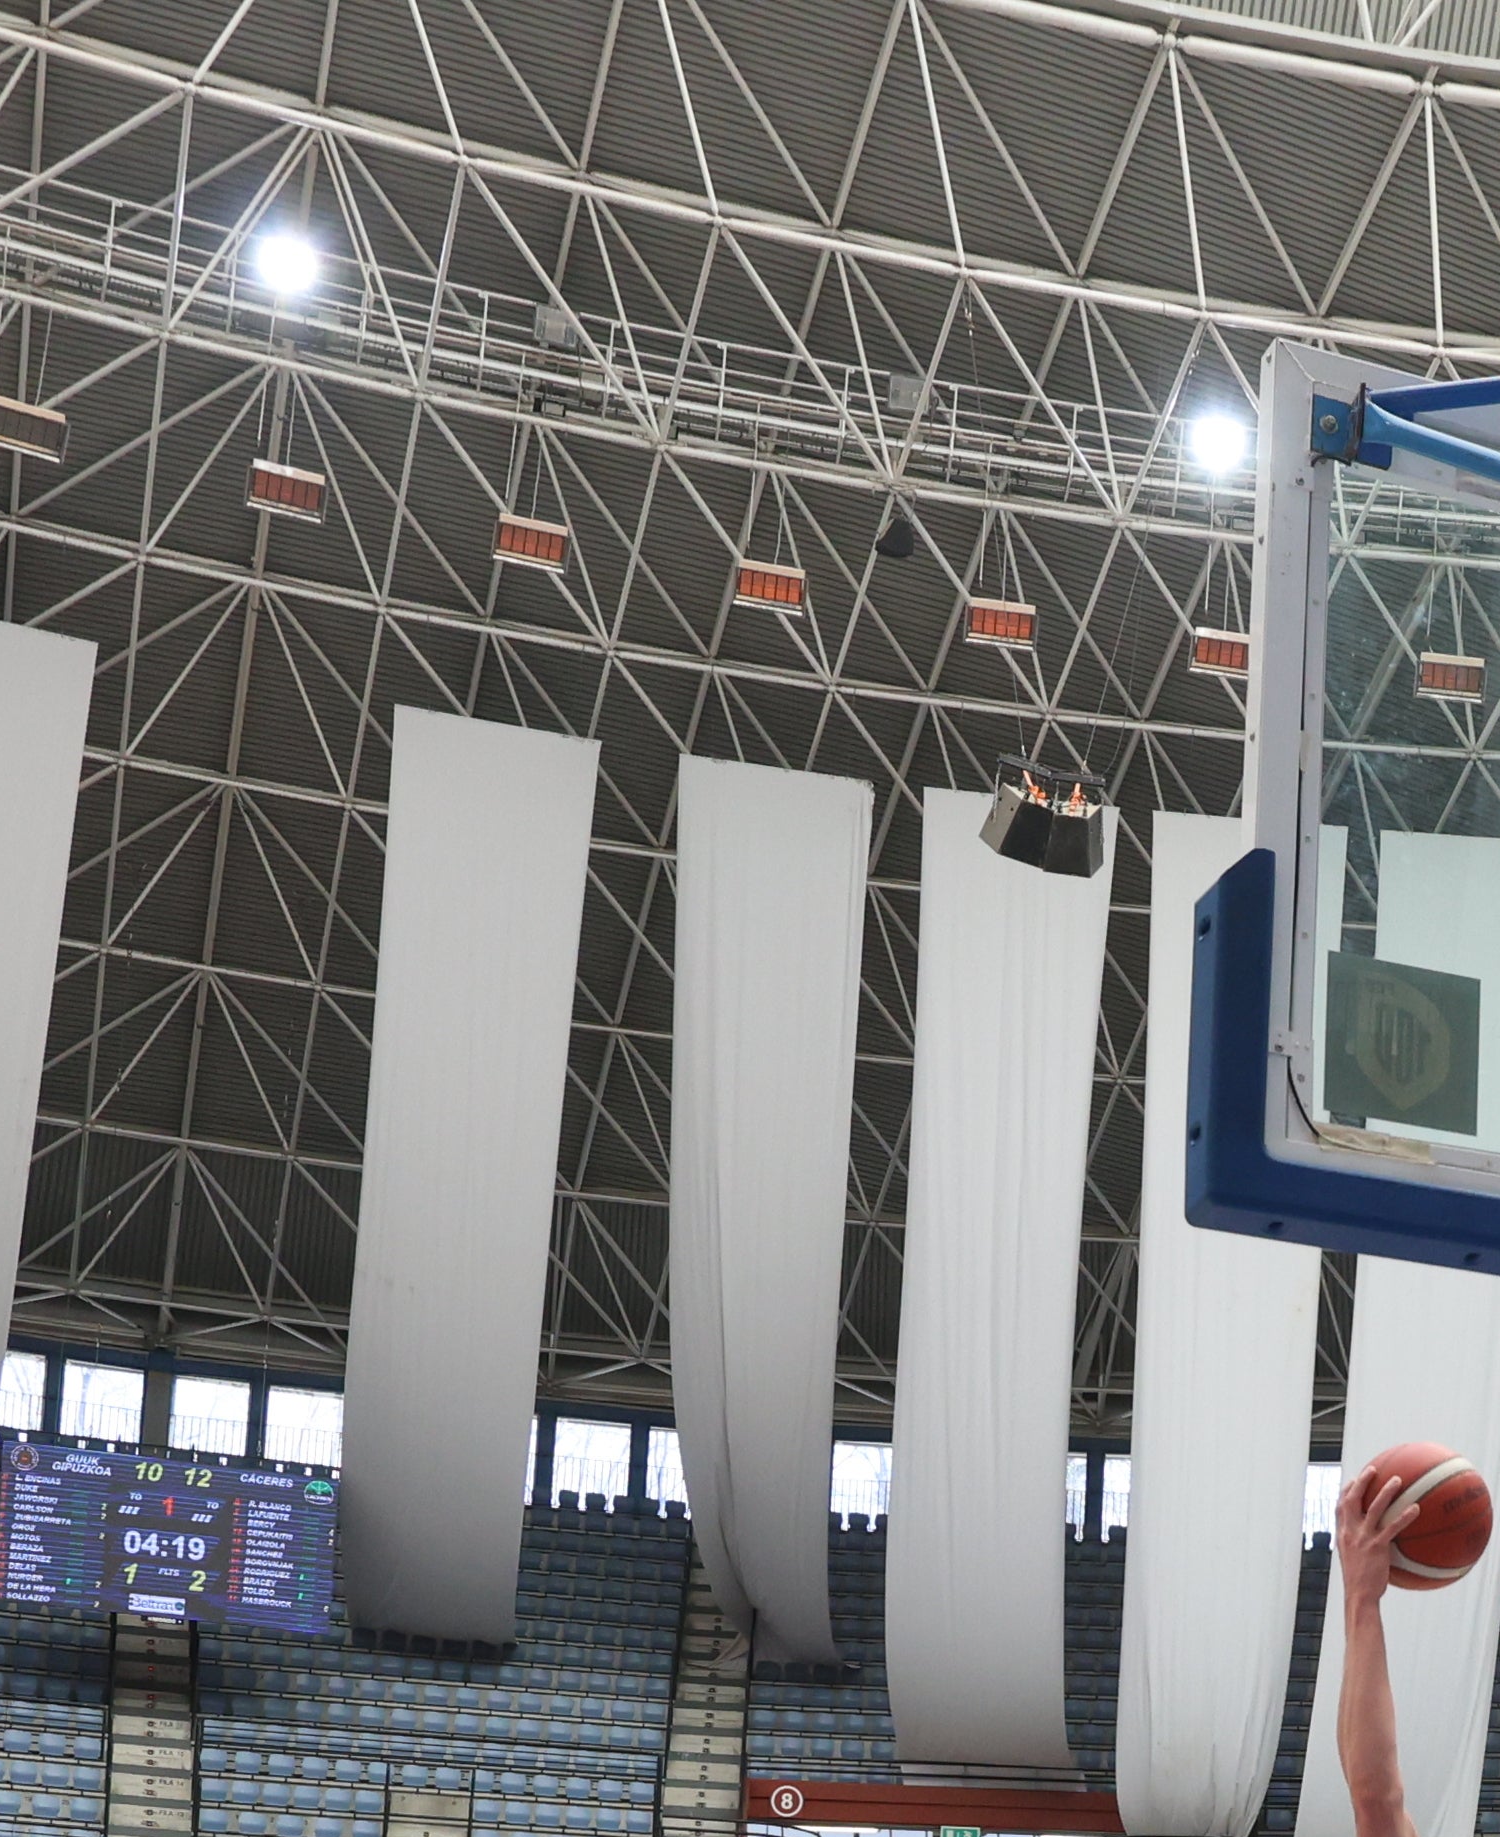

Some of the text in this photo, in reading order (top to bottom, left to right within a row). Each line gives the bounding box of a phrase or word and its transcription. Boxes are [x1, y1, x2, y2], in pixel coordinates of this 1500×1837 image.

[52, 1461, 112, 1477] GIPUZKOA
[65, 1453, 101, 1466] GUUK
[135, 1461, 164, 1482] 10
[184, 1467, 213, 1488] 12
[129, 1491, 143, 1501] TO
[162, 1496, 176, 1516] 1
[206, 1501, 220, 1510] TO
[123, 1530, 206, 1561] 04:19
[123, 1563, 139, 1585] 1
[188, 1570, 207, 1592] 2
[778, 1791, 795, 1813] 8
